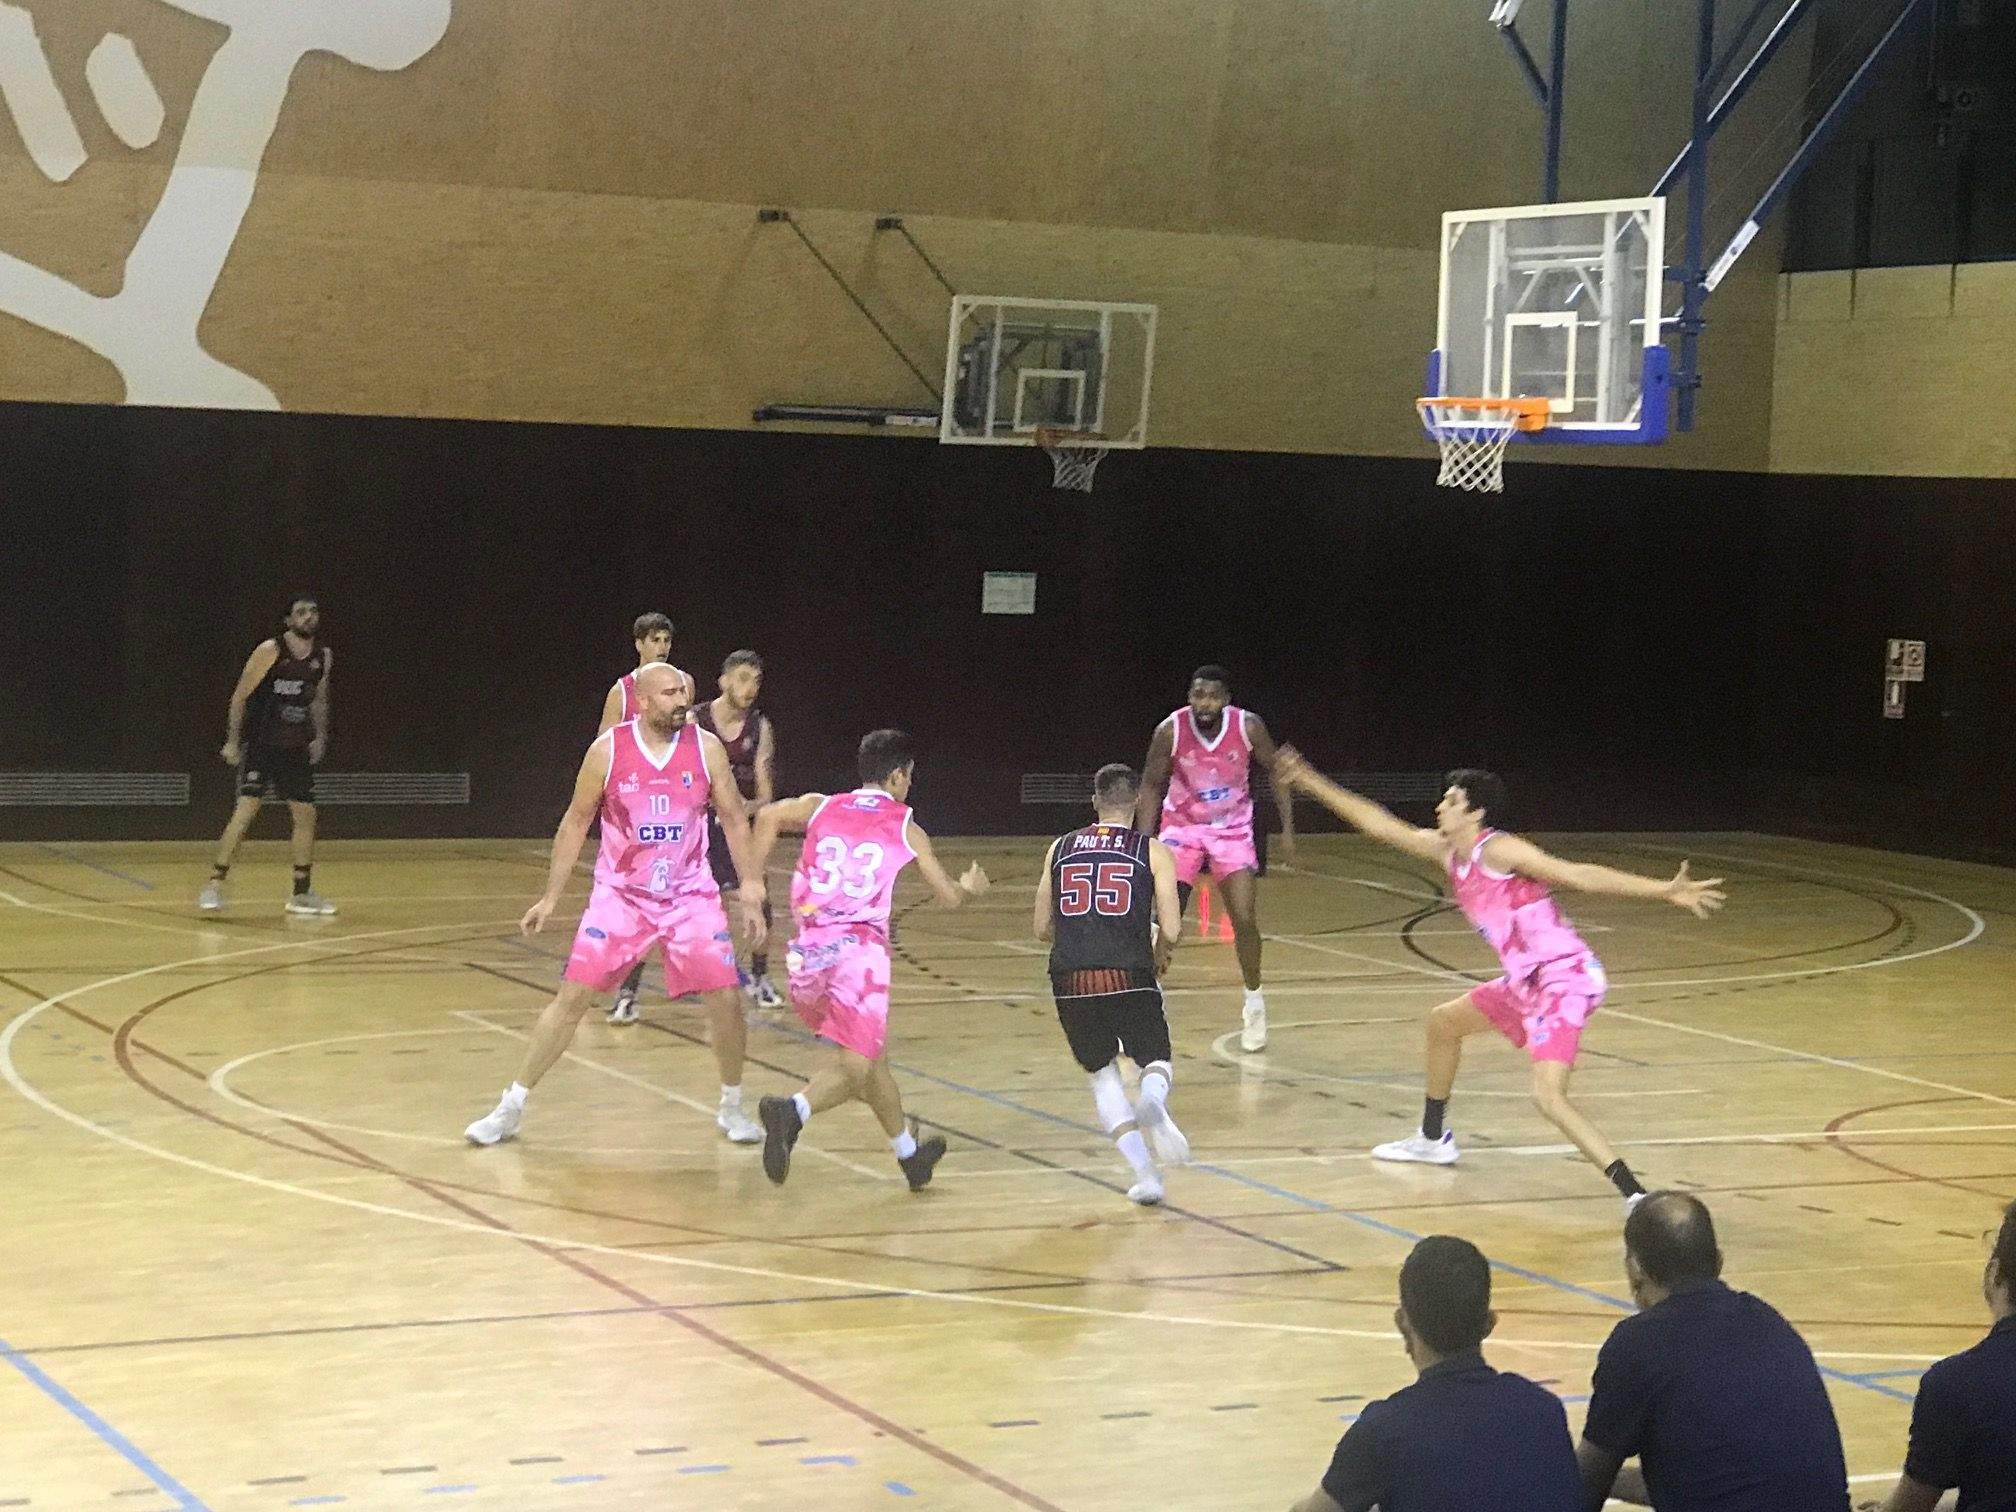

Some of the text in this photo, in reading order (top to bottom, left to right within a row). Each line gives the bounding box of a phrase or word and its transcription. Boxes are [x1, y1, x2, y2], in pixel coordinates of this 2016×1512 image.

[649, 794, 670, 817] 10
[638, 825, 683, 842] CBT
[1073, 835, 1097, 849] PAU
[809, 836, 885, 899] 33
[1060, 862, 1134, 916] 55
